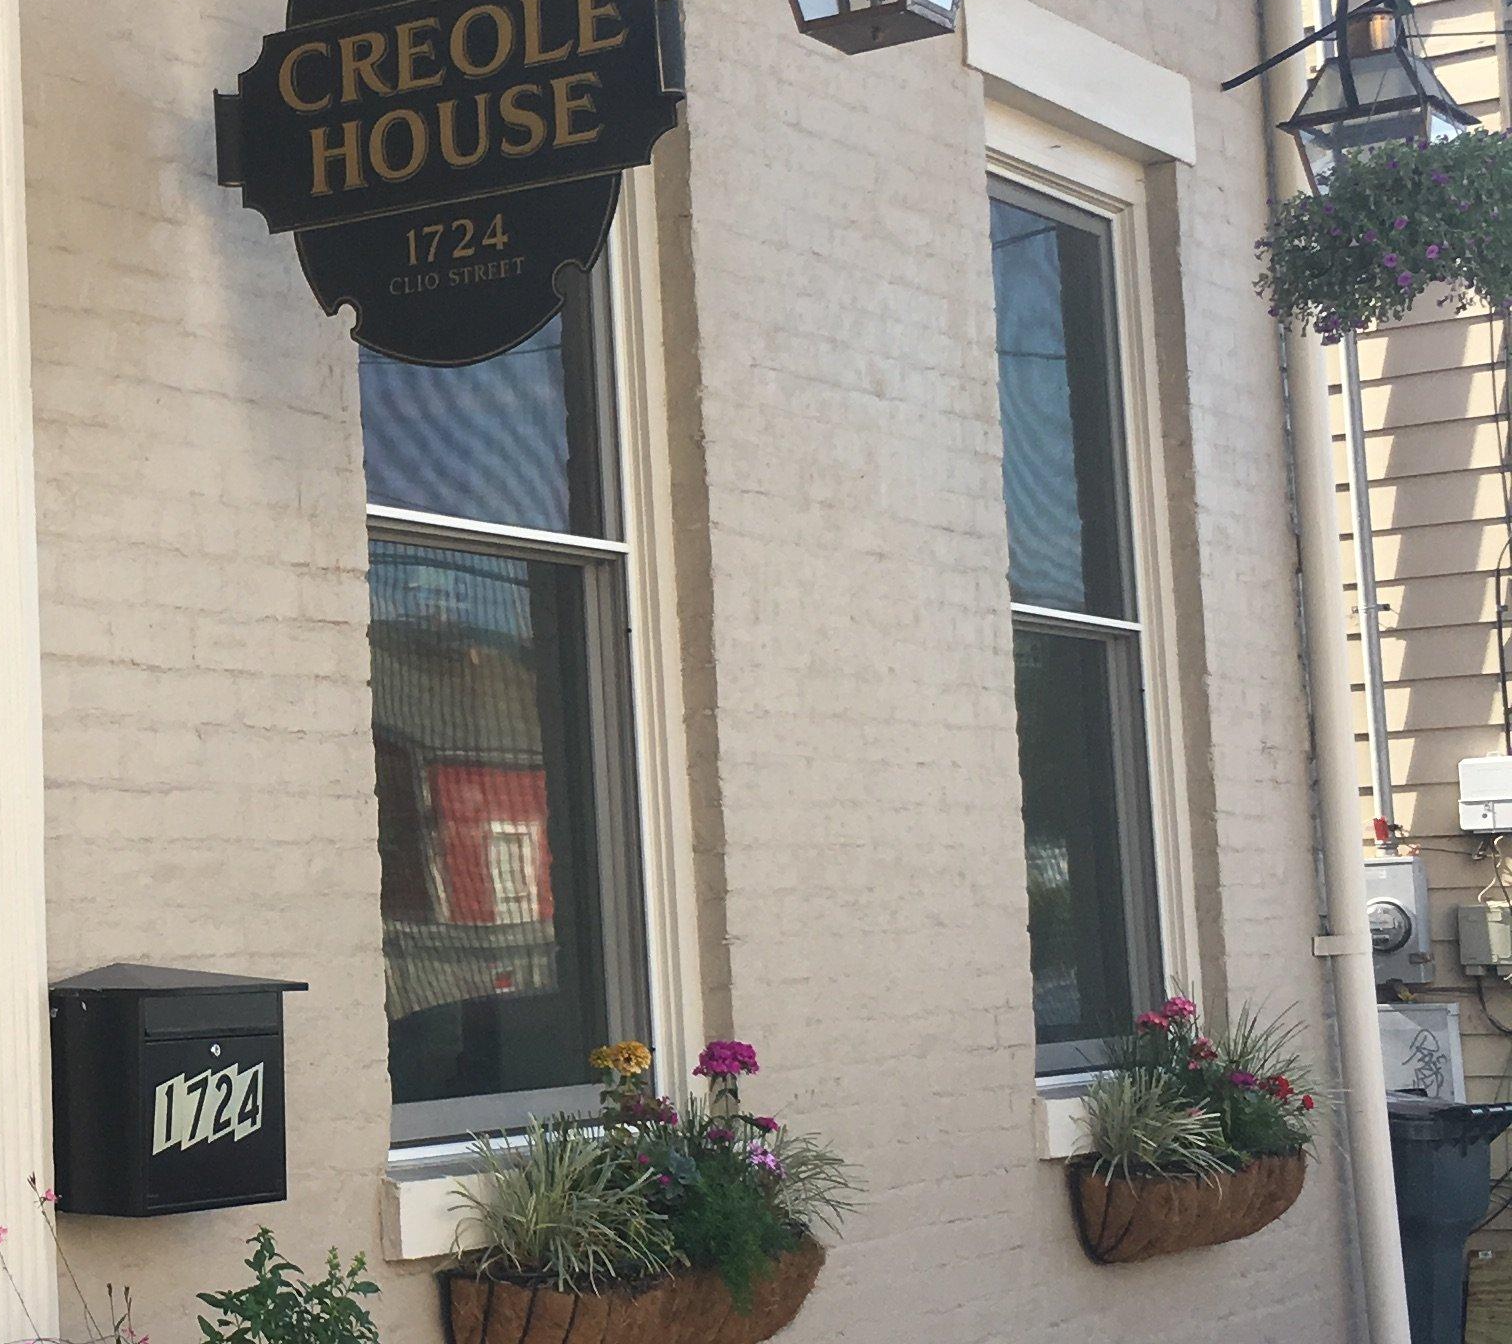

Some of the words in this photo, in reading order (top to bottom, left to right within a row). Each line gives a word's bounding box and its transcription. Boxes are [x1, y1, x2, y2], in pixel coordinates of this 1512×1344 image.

[309, 72, 604, 196] HOUSE
[406, 213, 510, 267] 1724
[389, 272, 440, 297] CLIO
[448, 255, 526, 287] STREET
[164, 1069, 260, 1144] 1724
